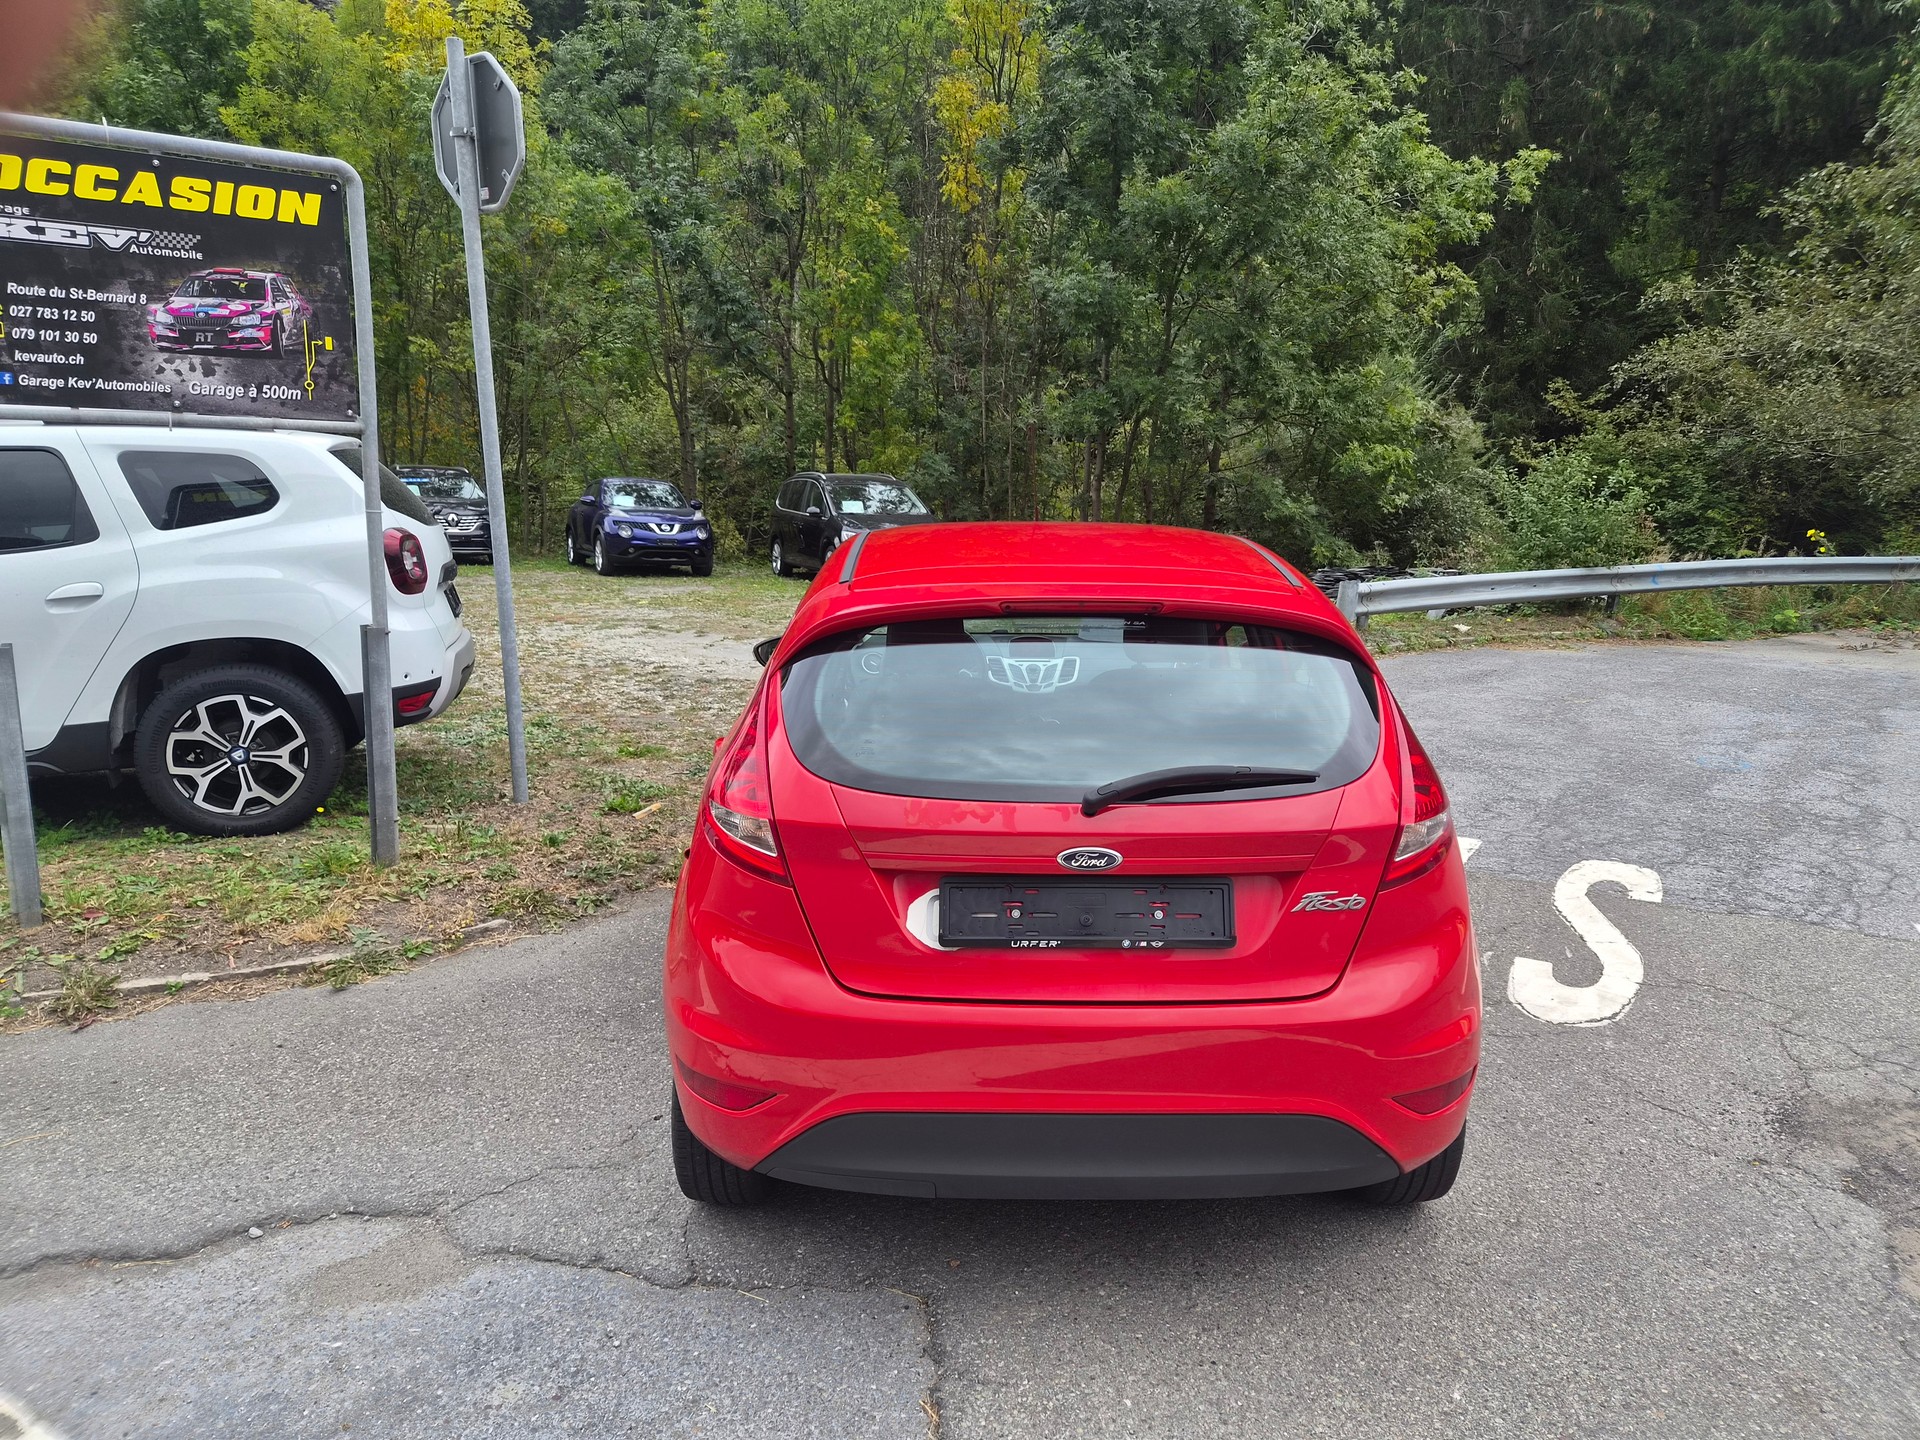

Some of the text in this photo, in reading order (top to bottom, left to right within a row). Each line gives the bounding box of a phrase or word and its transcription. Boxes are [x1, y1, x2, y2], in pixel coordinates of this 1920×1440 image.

[129, 244, 203, 260] Automobile
[7, 282, 147, 305] Route du St-Bernard 8
[9, 305, 96, 323] 027 783 12 50
[11, 327, 98, 344] 079 101 30 50
[195, 332, 214, 343] RT
[14, 350, 85, 365] kevauto.ch
[18, 374, 172, 393] Garage Kev'Automobiles
[188, 381, 302, 400] Garage à 500m
[1071, 852, 1109, 867] Ford
[1290, 890, 1367, 912] Fiesta
[1507, 858, 1663, 1028] S
